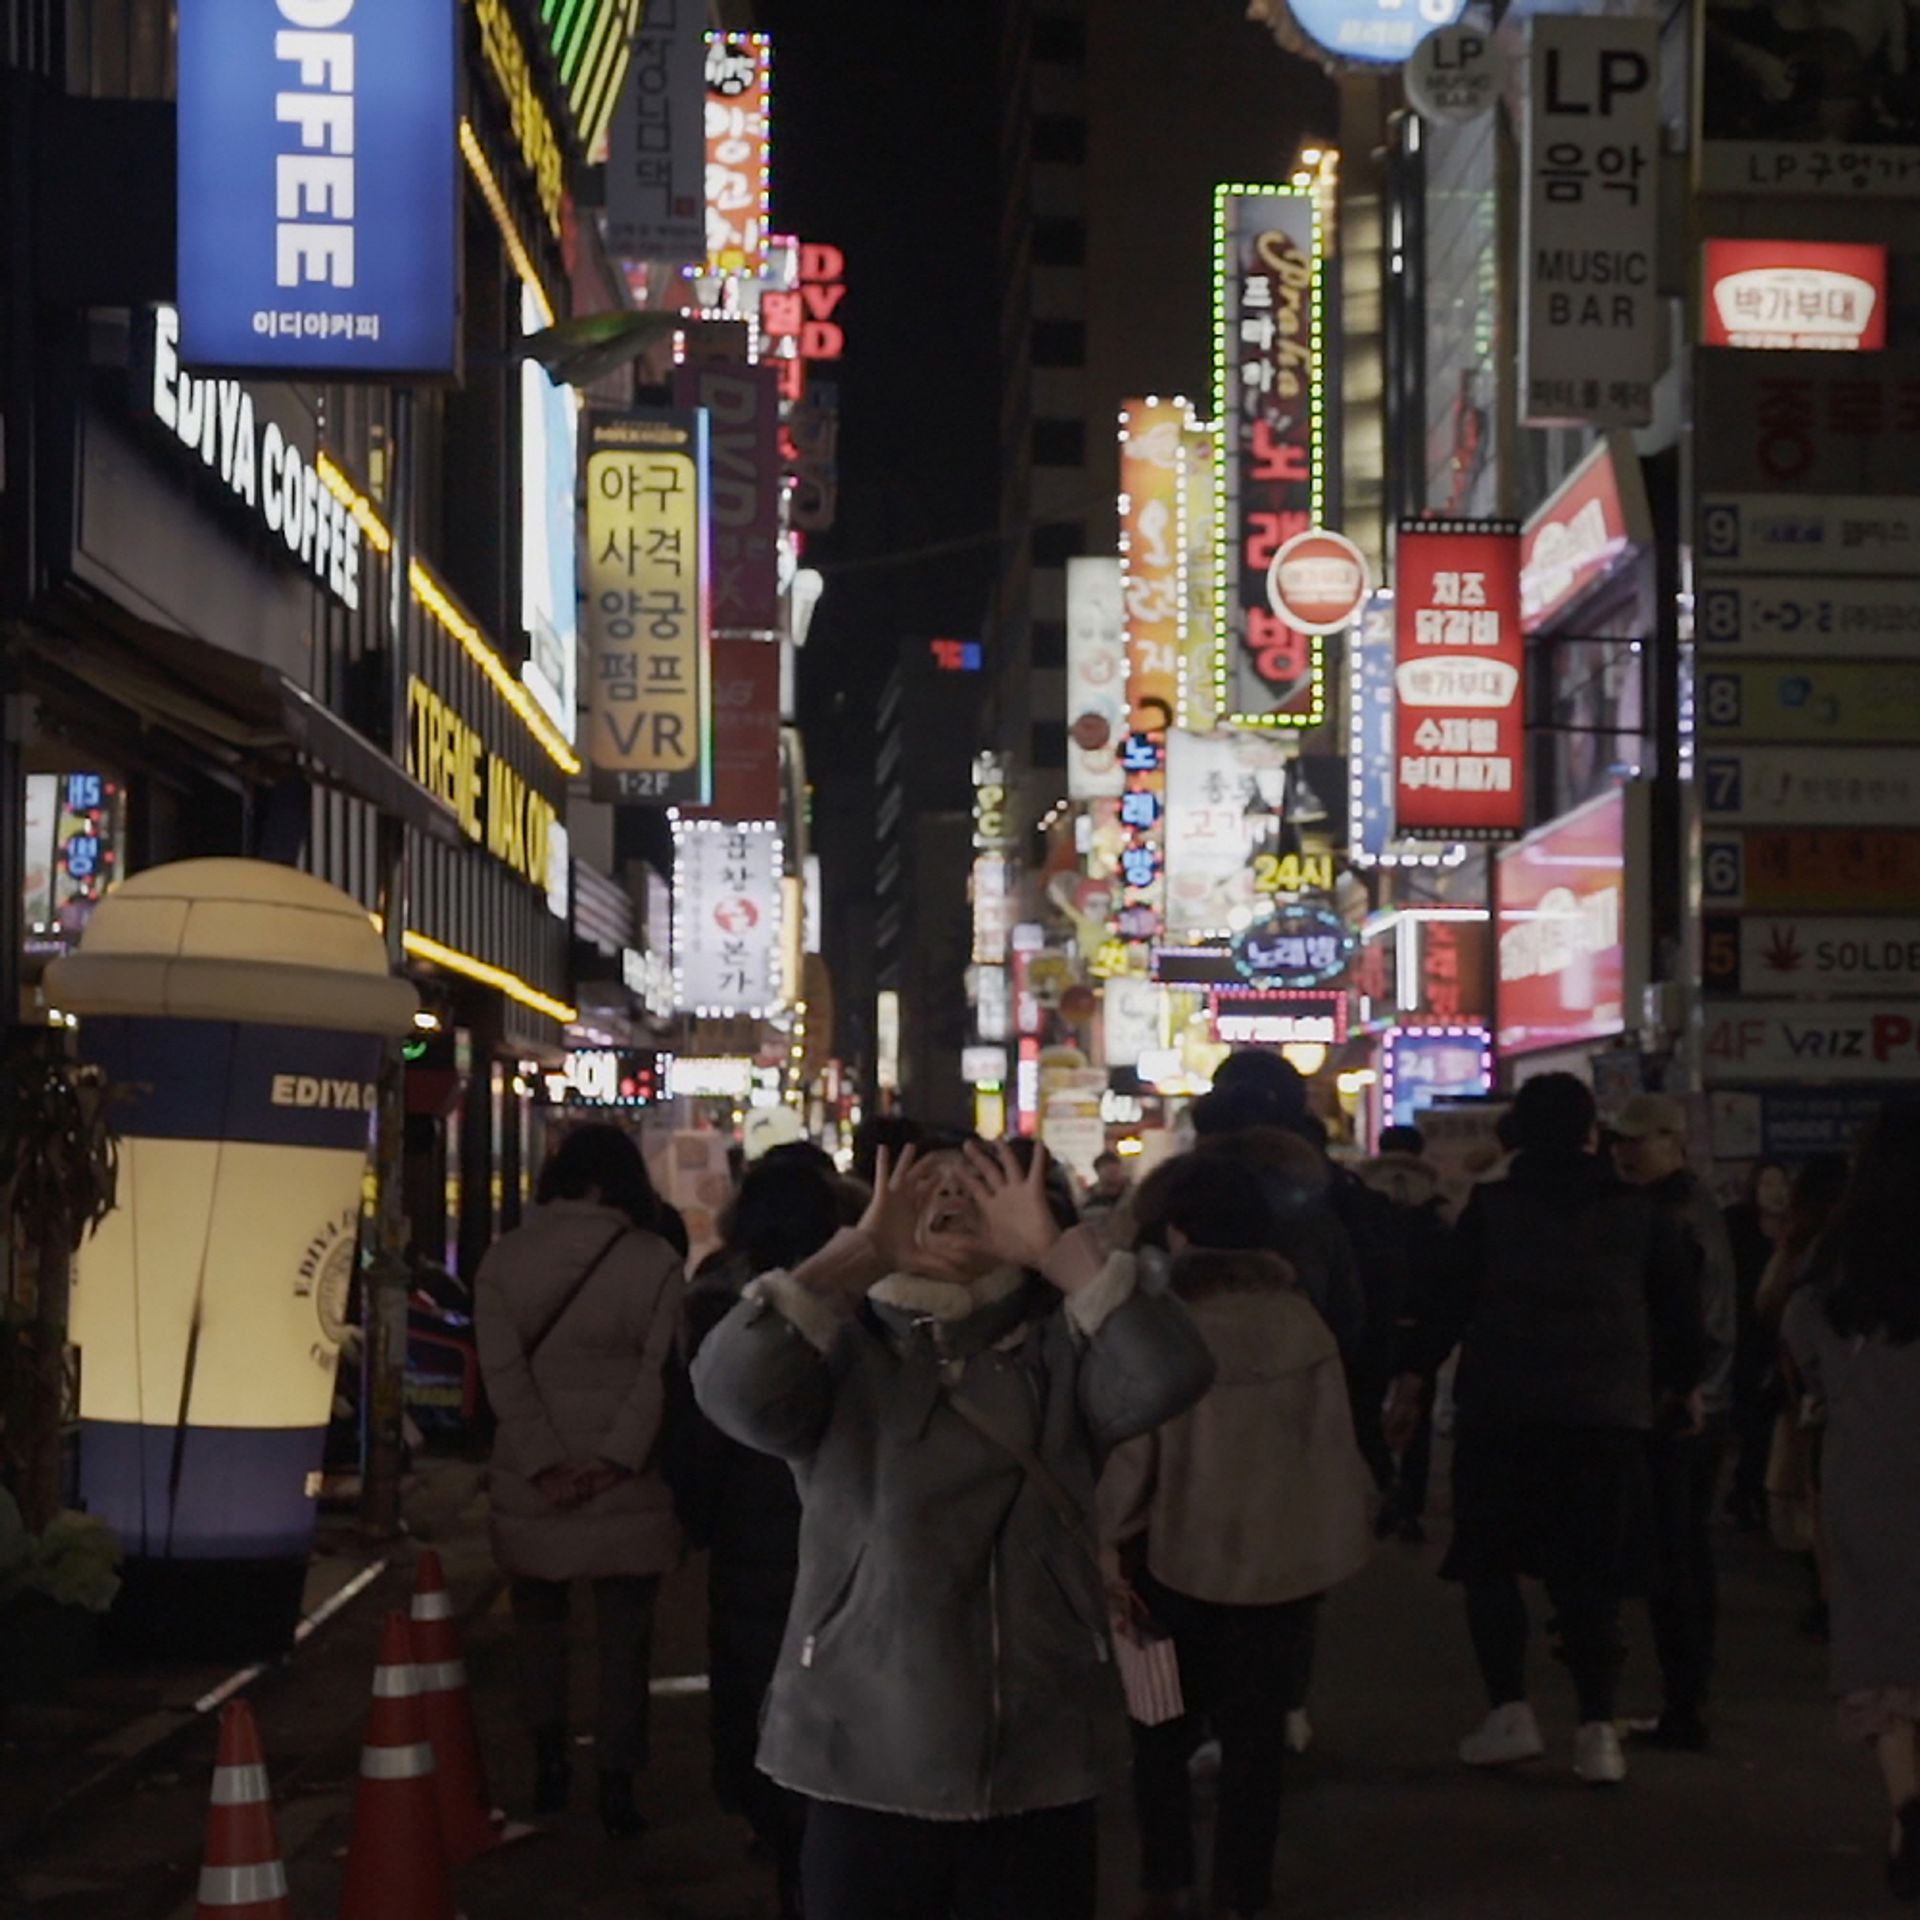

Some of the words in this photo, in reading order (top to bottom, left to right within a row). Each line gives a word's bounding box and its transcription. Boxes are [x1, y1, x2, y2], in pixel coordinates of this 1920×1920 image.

[1432, 37, 1482, 68] LP
[1545, 49, 1649, 116] LP
[1540, 142, 1645, 206] 음악
[1536, 250, 1647, 286] MUSIC
[800, 243, 846, 359] DVD
[1549, 292, 1635, 328] BAR
[1734, 287, 1856, 323] 박가부대
[600, 466, 684, 512] 야구
[261, 421, 359, 611] COFFEE
[1708, 511, 1734, 553] 9
[600, 527, 681, 577] 사격
[1432, 571, 1487, 606] 치즈
[600, 589, 685, 640] 양궁
[1415, 609, 1499, 646] 닭갈비
[1708, 595, 1735, 641] 8
[599, 654, 686, 702] 펌프
[1708, 680, 1735, 723] 8
[604, 711, 685, 758] VR
[1709, 764, 1735, 805] 7
[1254, 853, 1333, 892] 24시
[1708, 848, 1735, 891] 6
[1709, 934, 1735, 975] 5
[1703, 1018, 1766, 1060] 4F
[270, 1074, 360, 1111] EDIYA
